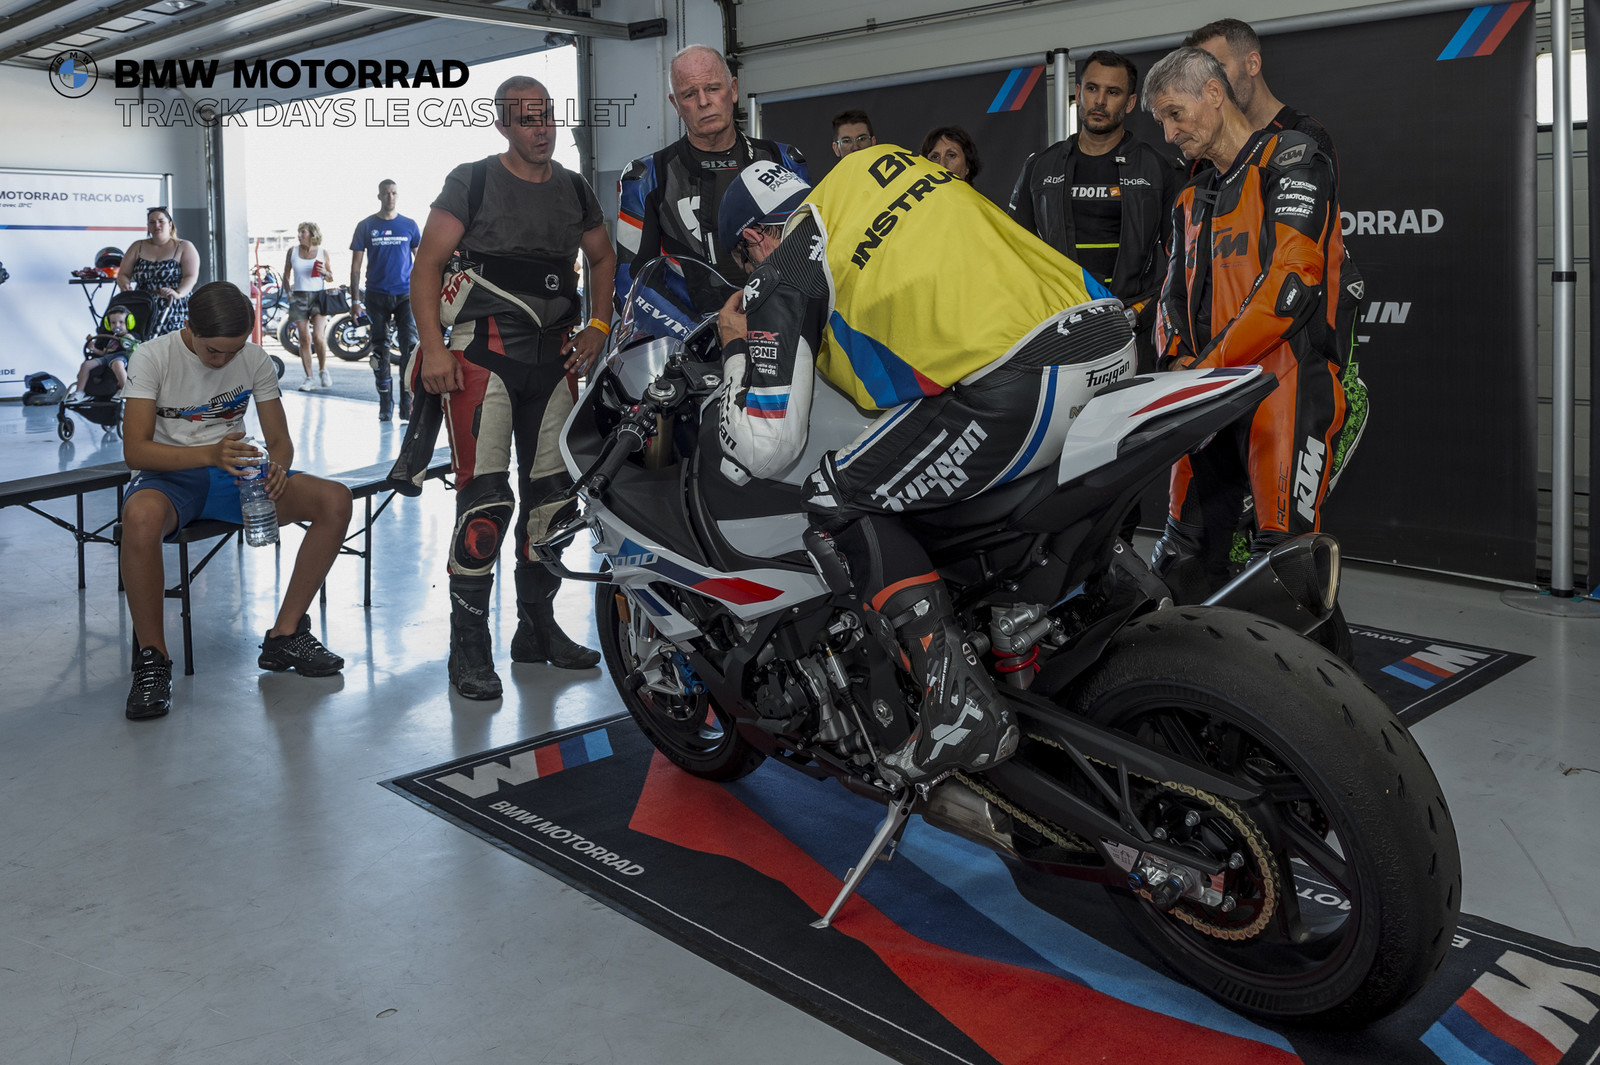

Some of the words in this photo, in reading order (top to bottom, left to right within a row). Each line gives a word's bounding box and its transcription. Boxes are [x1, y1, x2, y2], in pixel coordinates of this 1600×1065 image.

[73, 193, 112, 203] TRACK
[115, 194, 144, 203] DAYS
[1079, 187, 1095, 198] DO
[1285, 193, 1315, 204] MOTOREX
[1340, 208, 1444, 236] ORRAD
[1293, 435, 1326, 523] KTM
[488, 800, 543, 825] BMW
[532, 821, 645, 876] MOTORRAD
